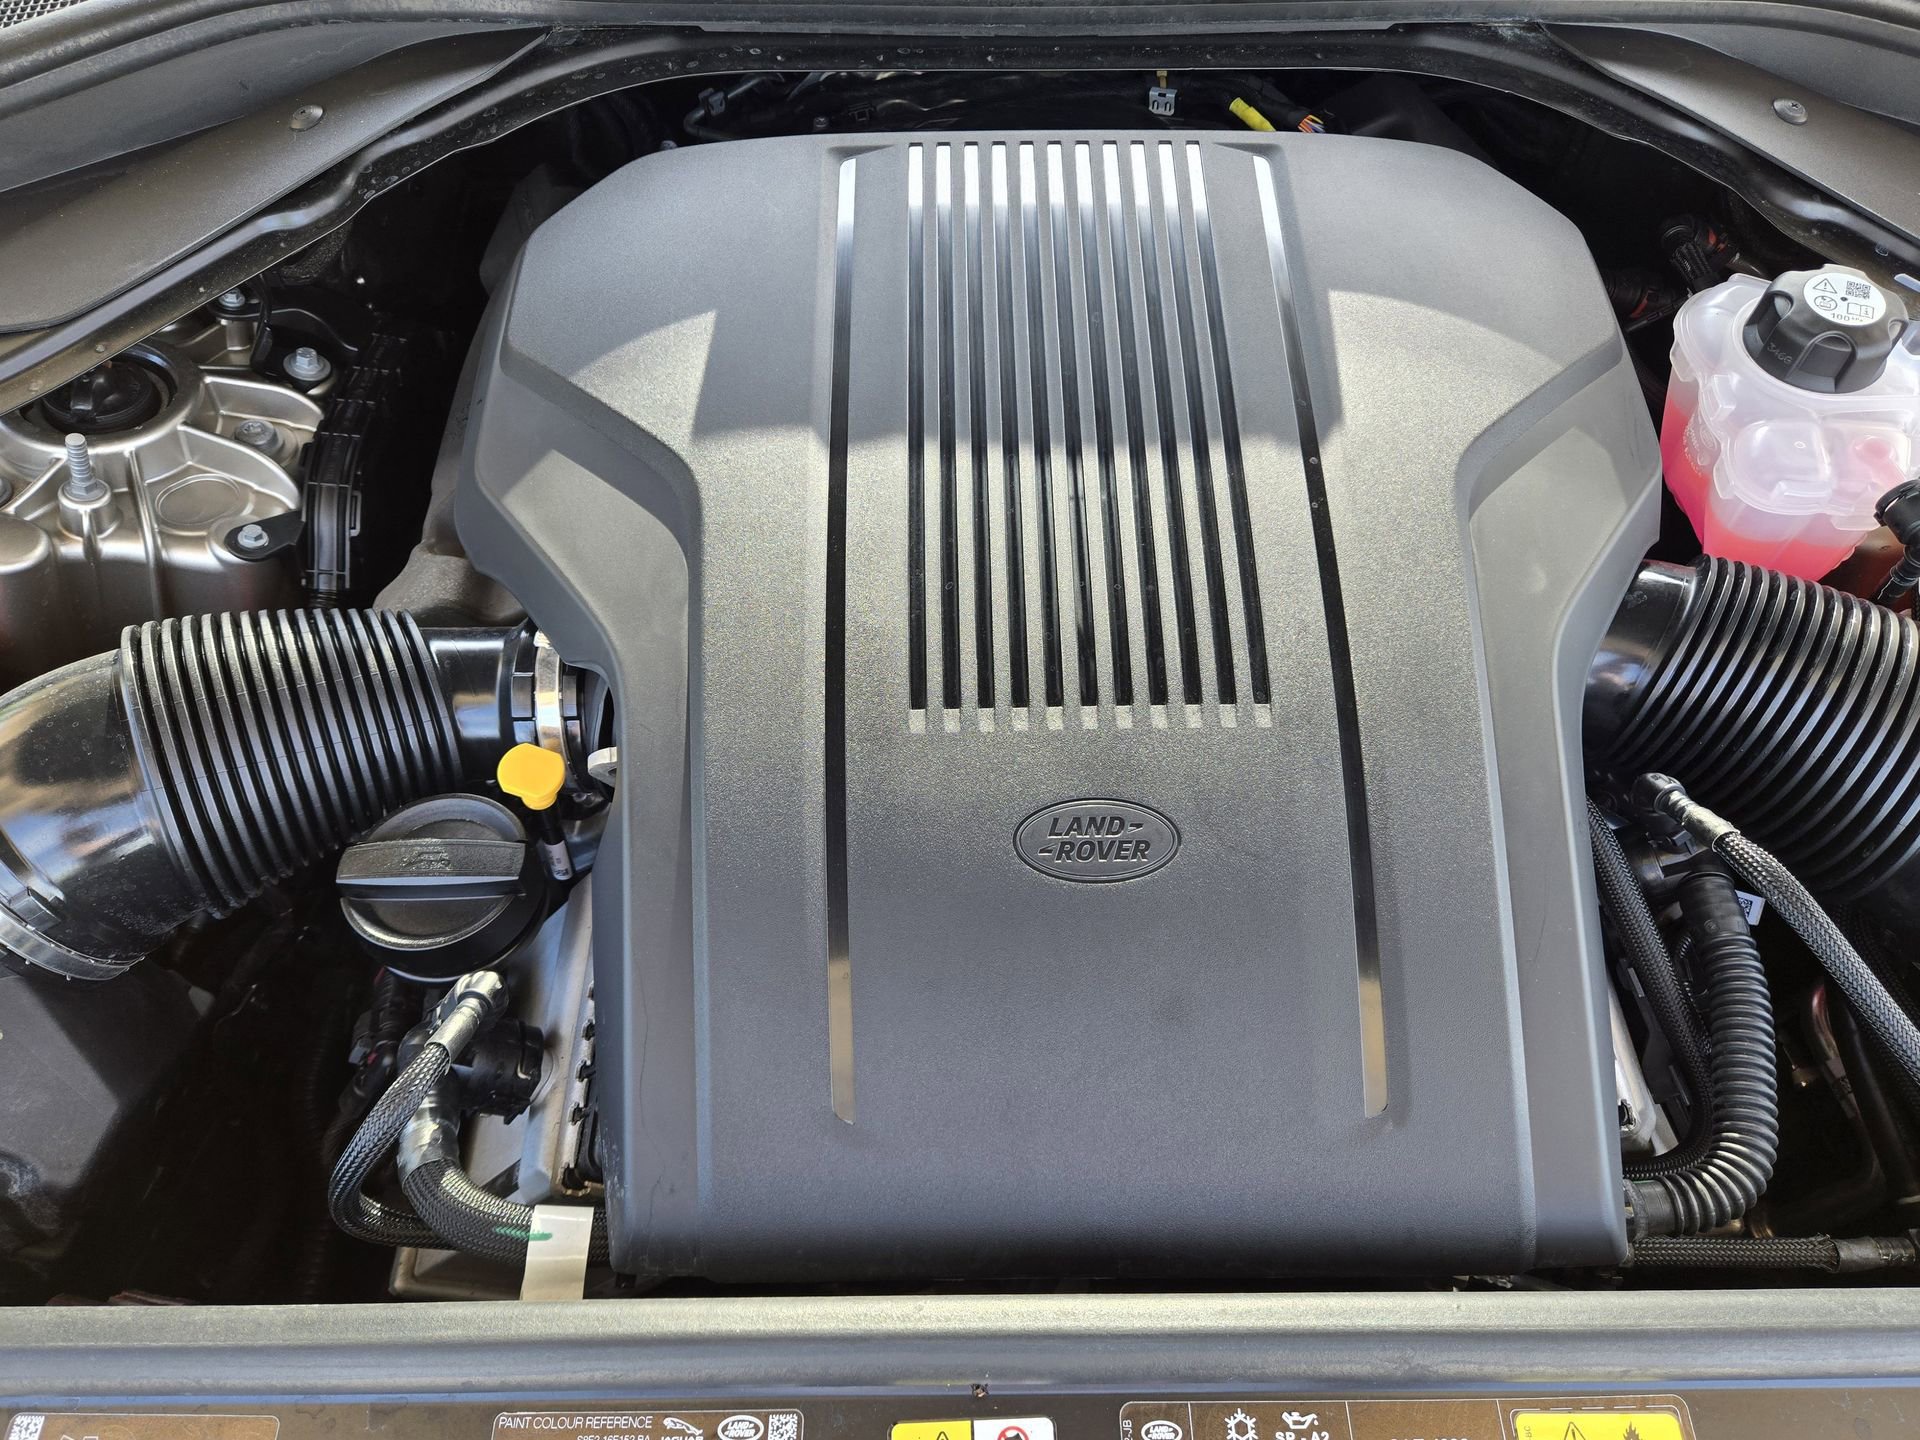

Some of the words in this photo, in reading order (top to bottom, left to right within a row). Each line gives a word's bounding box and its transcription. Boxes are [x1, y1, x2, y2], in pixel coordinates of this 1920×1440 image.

[1831, 312, 1850, 321] 100
[1047, 816, 1126, 838] LAND
[1054, 839, 1151, 862] ROVER
[498, 1416, 531, 1429] PAINT
[533, 1416, 584, 1429] COLOUR
[585, 1416, 653, 1429] REFERENCE
[727, 1421, 751, 1429] LAND
[728, 1429, 756, 1437] ROVER
